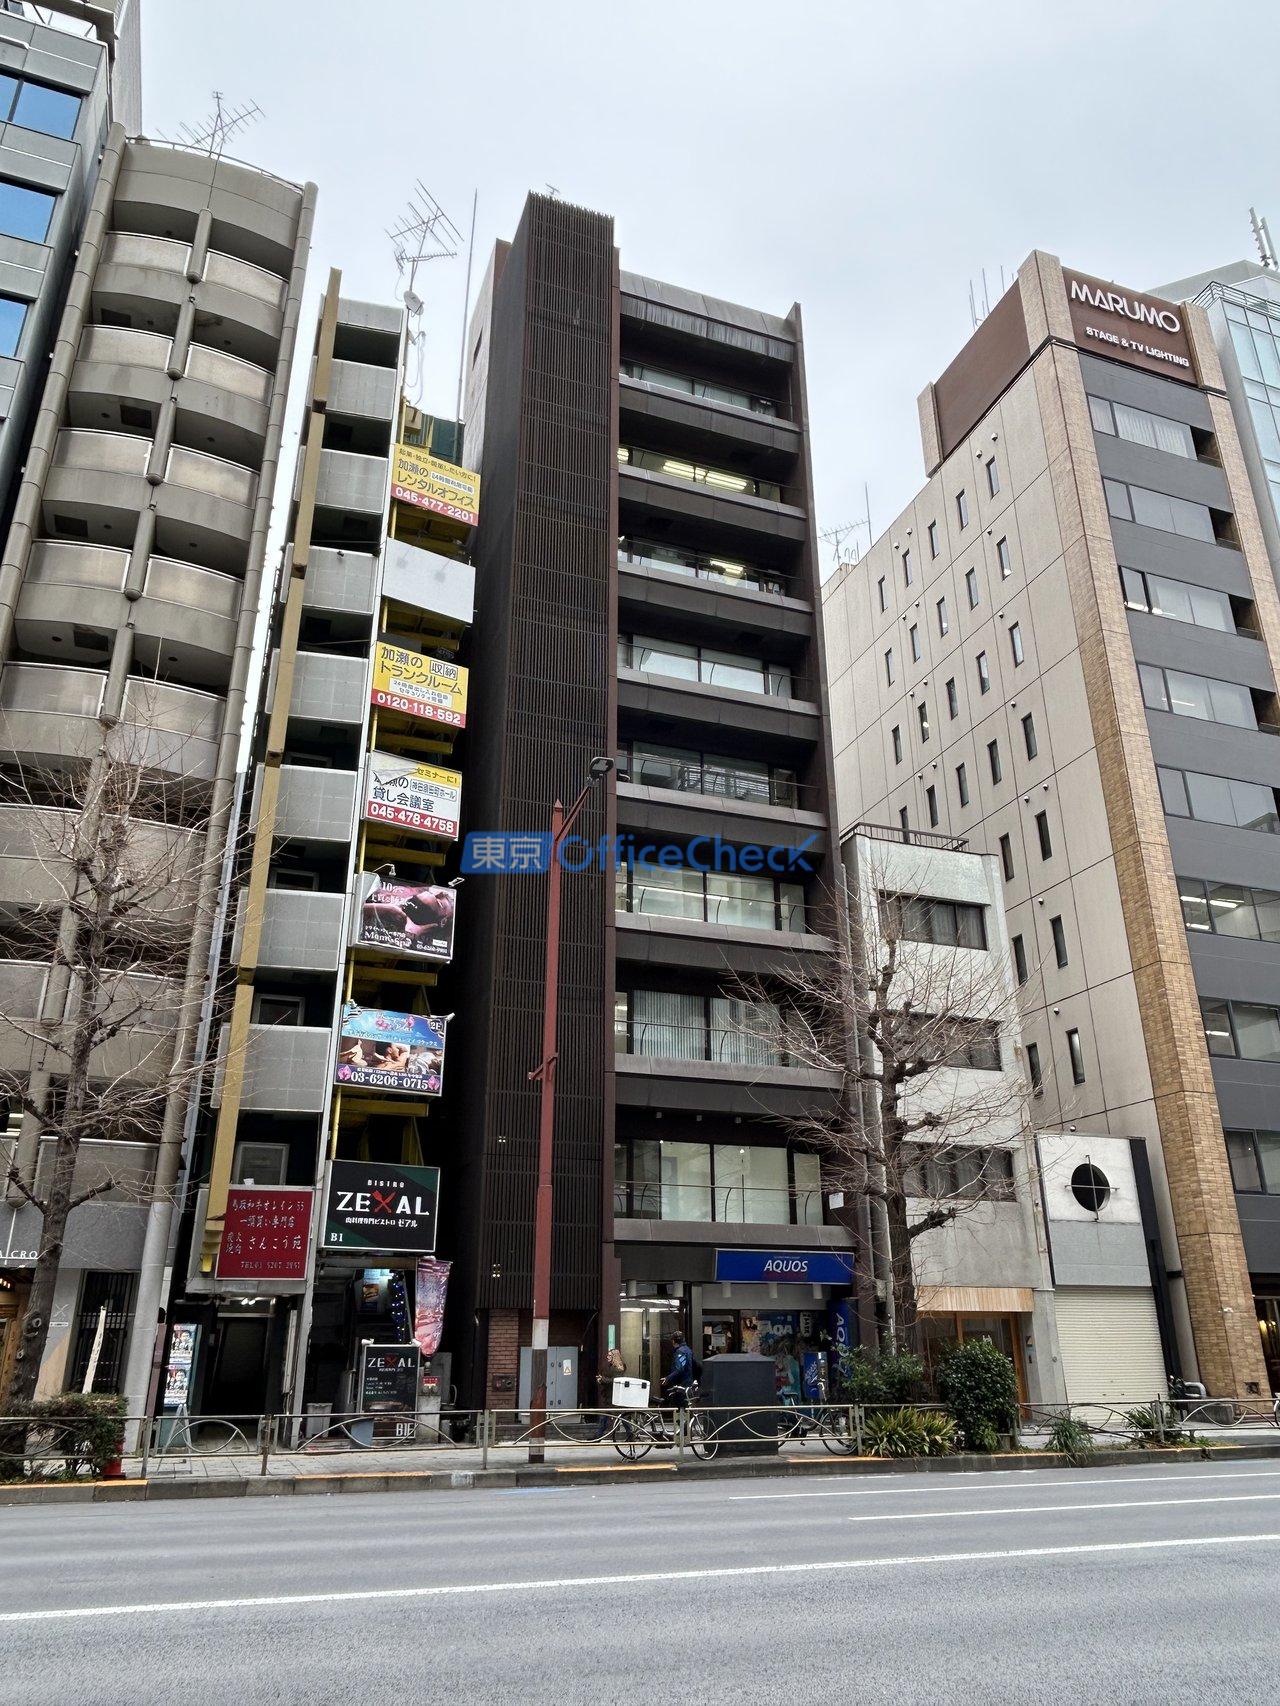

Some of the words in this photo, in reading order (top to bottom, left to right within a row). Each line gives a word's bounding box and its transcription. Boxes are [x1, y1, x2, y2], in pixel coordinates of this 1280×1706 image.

[1071, 280, 1180, 333] MARUMO
[1086, 326, 1119, 344] STAGE
[1121, 338, 1129, 348] &
[1130, 340, 1144, 352] TV
[1145, 346, 1190, 367] LIGHTING
[397, 471, 475, 509] レンタルオフィス
[381, 646, 423, 668] 加瀬の
[380, 660, 463, 696] トランクルーム
[431, 662, 457, 681] 収納
[373, 785, 435, 813] 貸し会議室
[350, 1071, 429, 1090] 03-6206-0715
[763, 1260, 809, 1273] AQUOS
